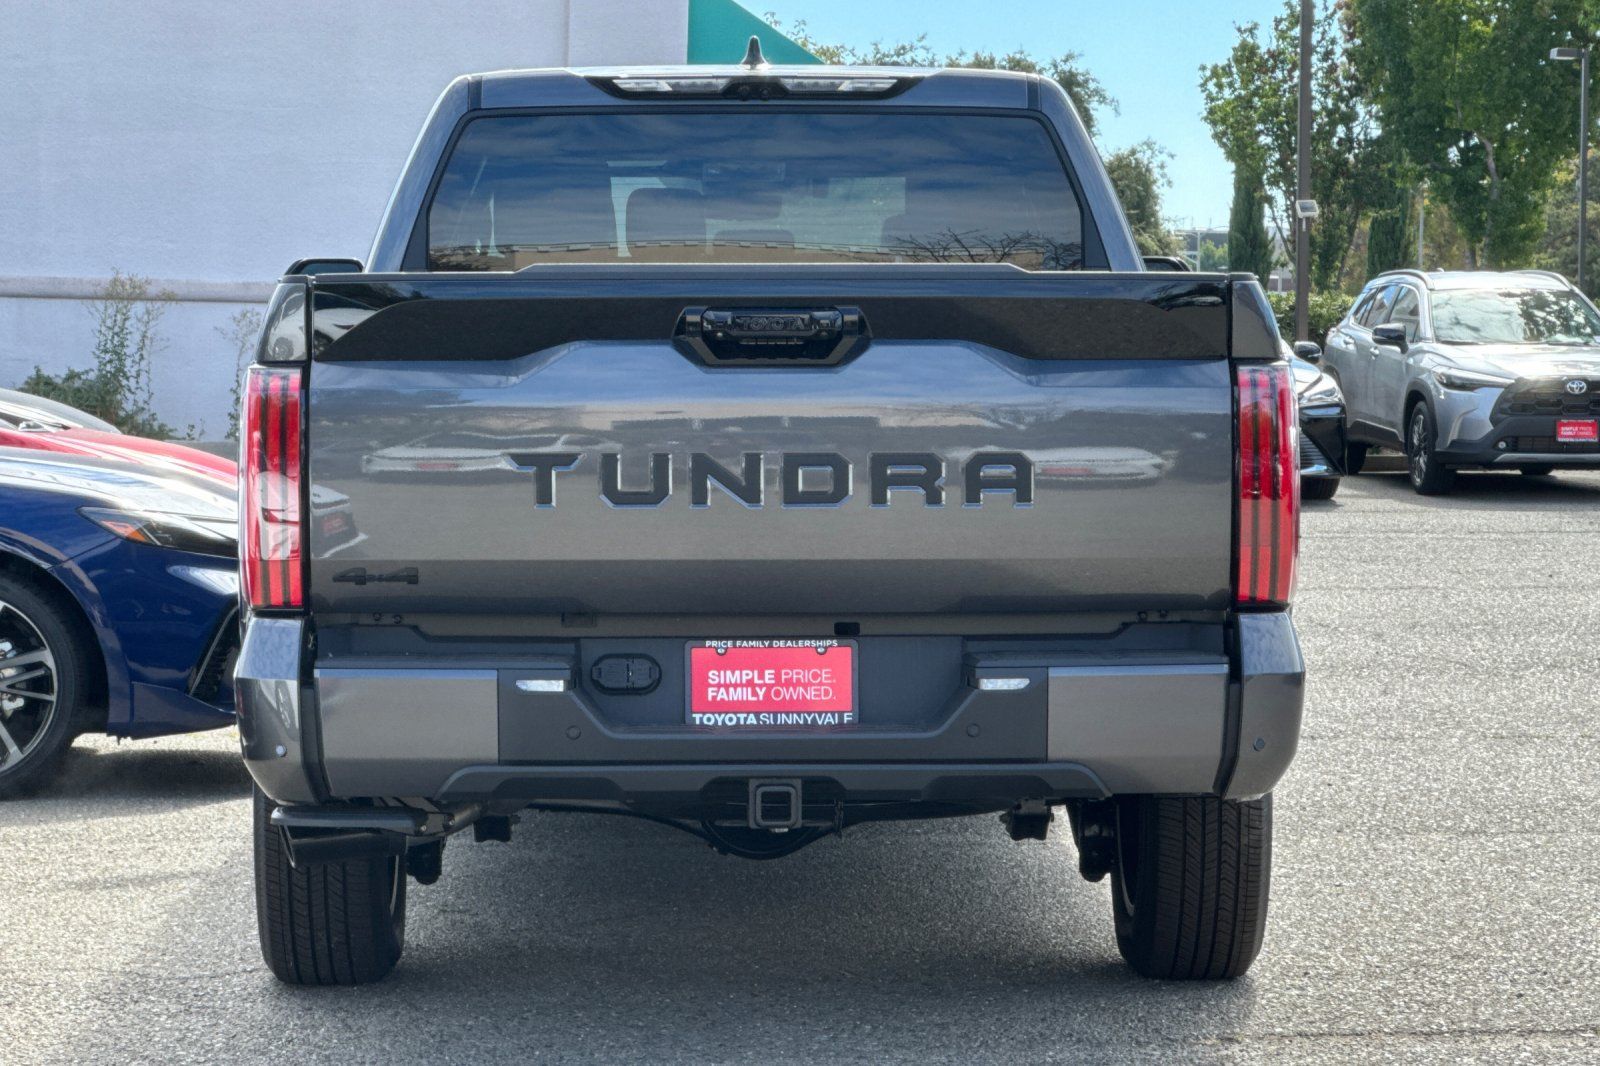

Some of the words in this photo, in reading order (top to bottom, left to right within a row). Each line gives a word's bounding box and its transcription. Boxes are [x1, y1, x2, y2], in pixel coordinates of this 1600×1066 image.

[739, 316, 804, 330] TOYOTA
[503, 451, 1035, 510] TUNDRA
[706, 640, 733, 648] PRICE
[736, 640, 769, 648] FAMILY
[772, 639, 838, 648] DEALERSHIPS
[708, 670, 775, 684] SIMPLE
[781, 669, 836, 683] PRICE.
[707, 687, 767, 701] FAMILY
[771, 686, 836, 701] OWNED.
[692, 713, 757, 726] TOYOTA
